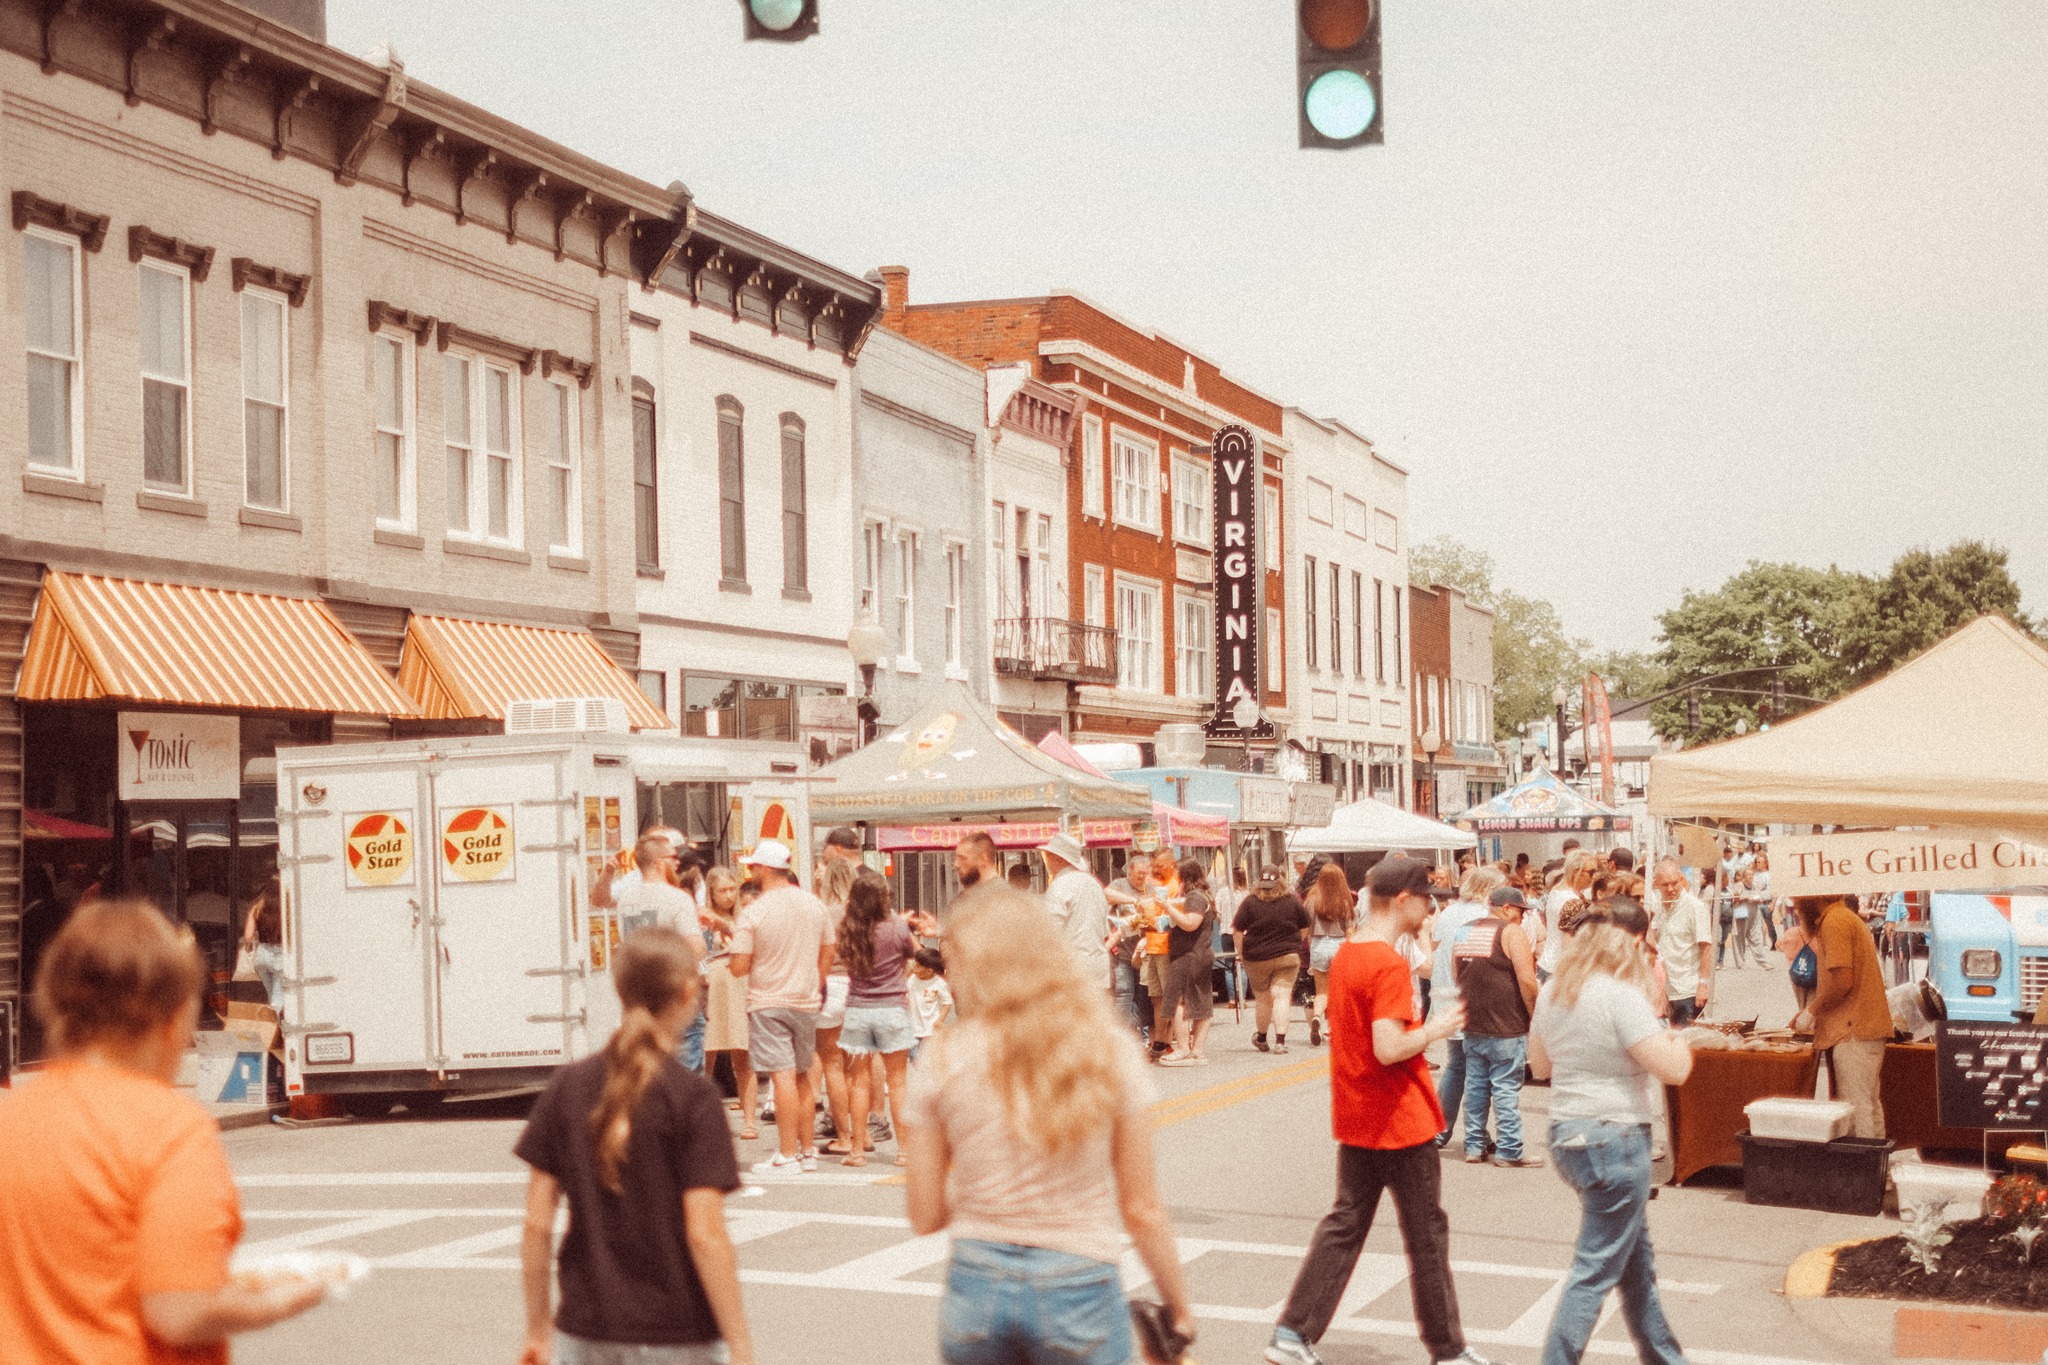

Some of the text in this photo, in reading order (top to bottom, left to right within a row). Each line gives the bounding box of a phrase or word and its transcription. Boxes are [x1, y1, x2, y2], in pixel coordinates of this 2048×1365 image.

[1222, 458, 1247, 702] VIRGINIA
[906, 790, 945, 805] CORN
[973, 788, 1000, 802] THE
[1005, 787, 1035, 800] COB
[1478, 817, 1582, 830] LEMON SHAKE UPS
[365, 839, 402, 855] Gold
[462, 834, 502, 850] Gold
[367, 856, 403, 870] Star
[465, 850, 502, 865] Star
[1790, 851, 1851, 878] The
[1865, 843, 1978, 875] Grilled
[1946, 1028, 1971, 1036] Thank
[2009, 1030, 2035, 1038] festival
[2000, 1042, 2041, 1051] cumberland
